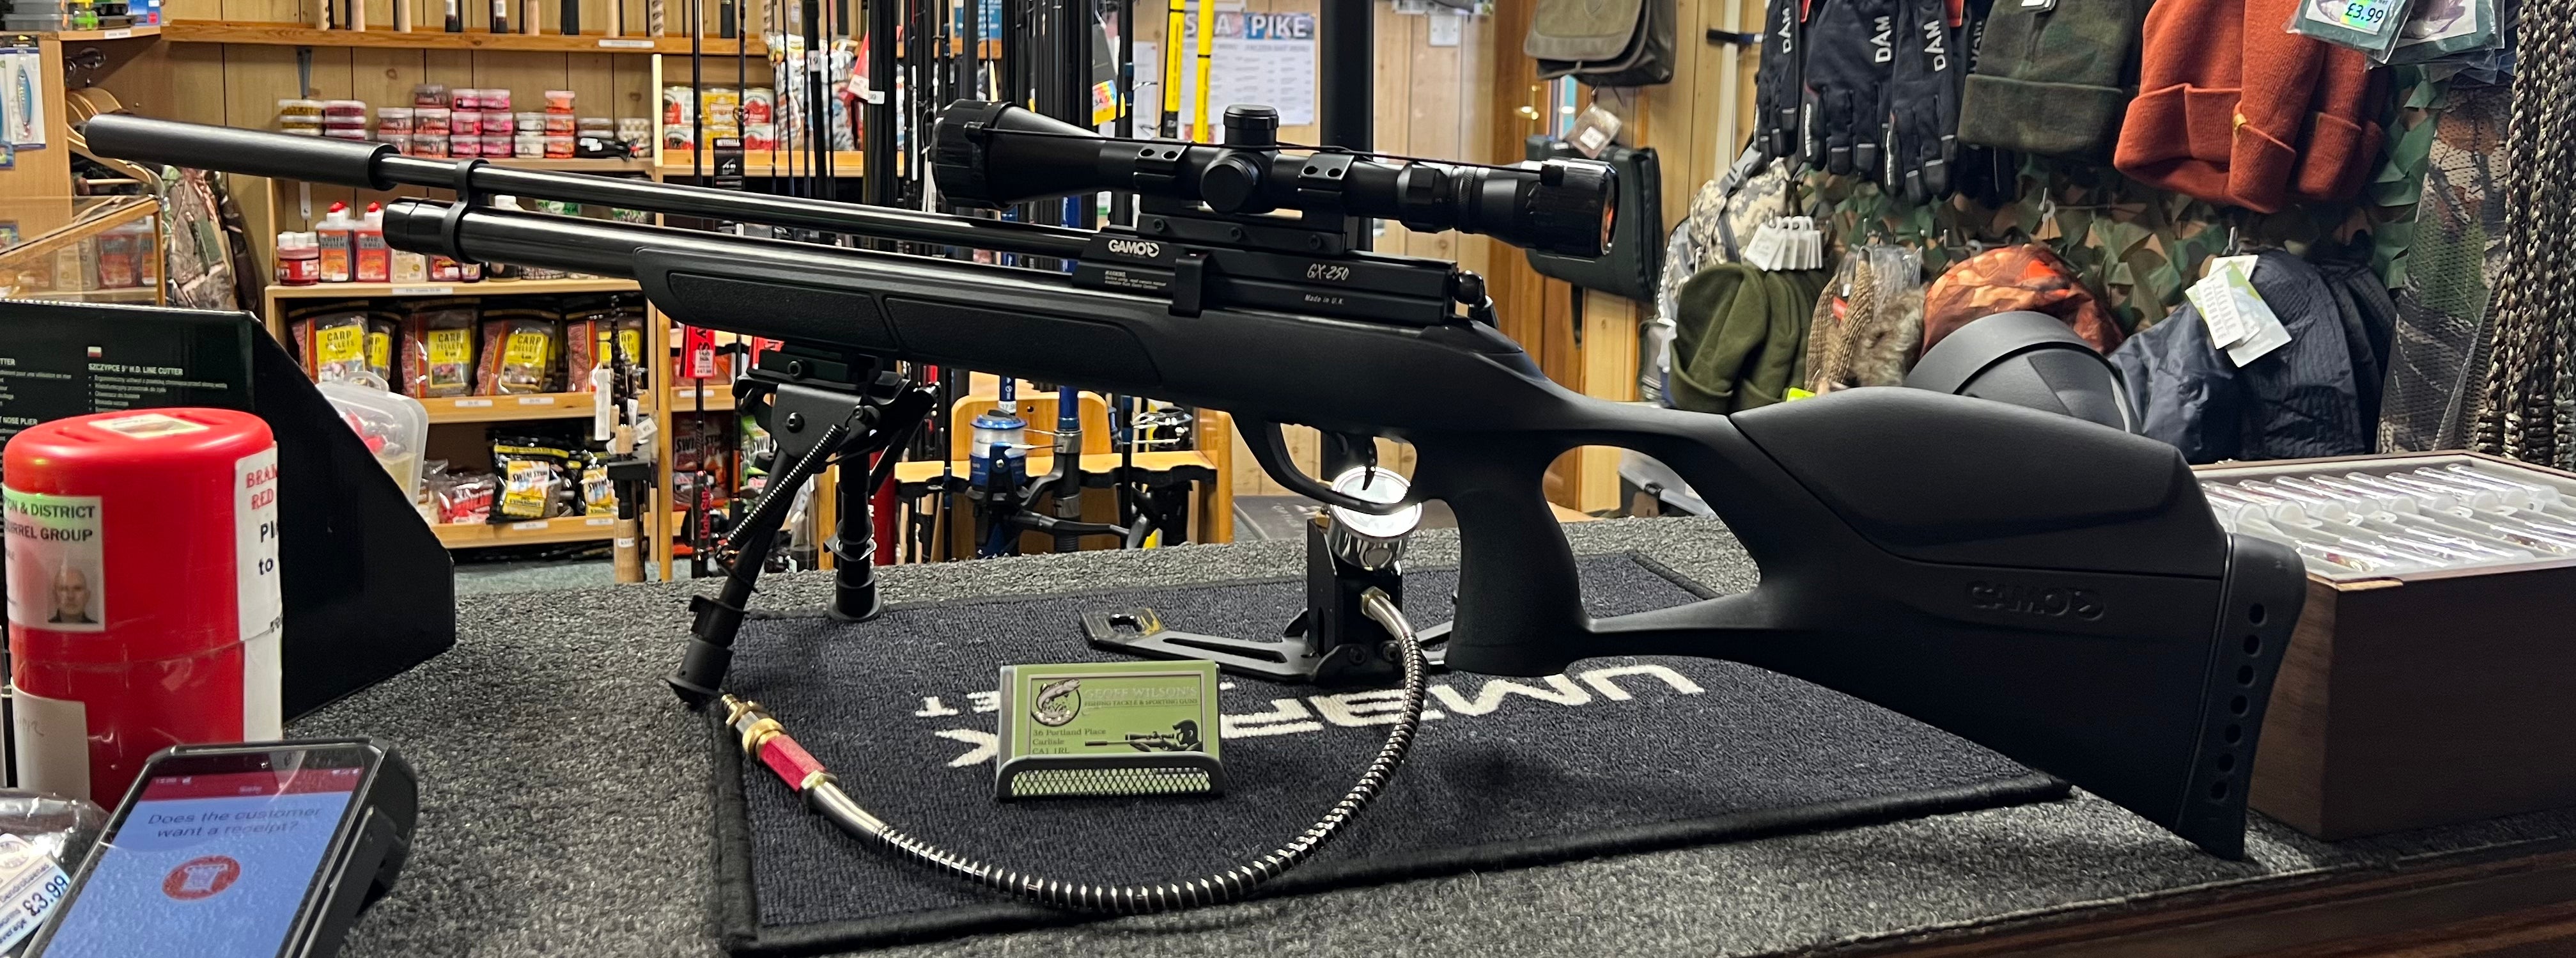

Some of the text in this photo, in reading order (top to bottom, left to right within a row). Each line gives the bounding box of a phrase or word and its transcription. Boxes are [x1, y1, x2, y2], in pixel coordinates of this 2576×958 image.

[2345, 3, 2384, 24] £3.99
[1185, 13, 1232, 35] SA
[1251, 15, 1308, 38] PIKE
[1778, 7, 1792, 54] DAM
[1870, 15, 1891, 63] DAM
[1924, 20, 1946, 72] DAM
[1108, 239, 1147, 255] GAMO
[1307, 263, 1349, 281] GX-250
[327, 330, 352, 342] CARP
[438, 333, 462, 342] CARP
[517, 334, 542, 345] CARP
[158, 367, 183, 375] CUTTER
[3, 416, 19, 425] NOSE
[251, 488, 274, 510] RED
[20, 502, 28, 515] &
[31, 503, 95, 519] DISTRICT
[40, 528, 93, 542] GROUP
[258, 557, 274, 576] to
[148, 807, 321, 825] Does the customer
[157, 826, 203, 838] want
[206, 826, 218, 836] a
[22, 874, 69, 916] £3.99
